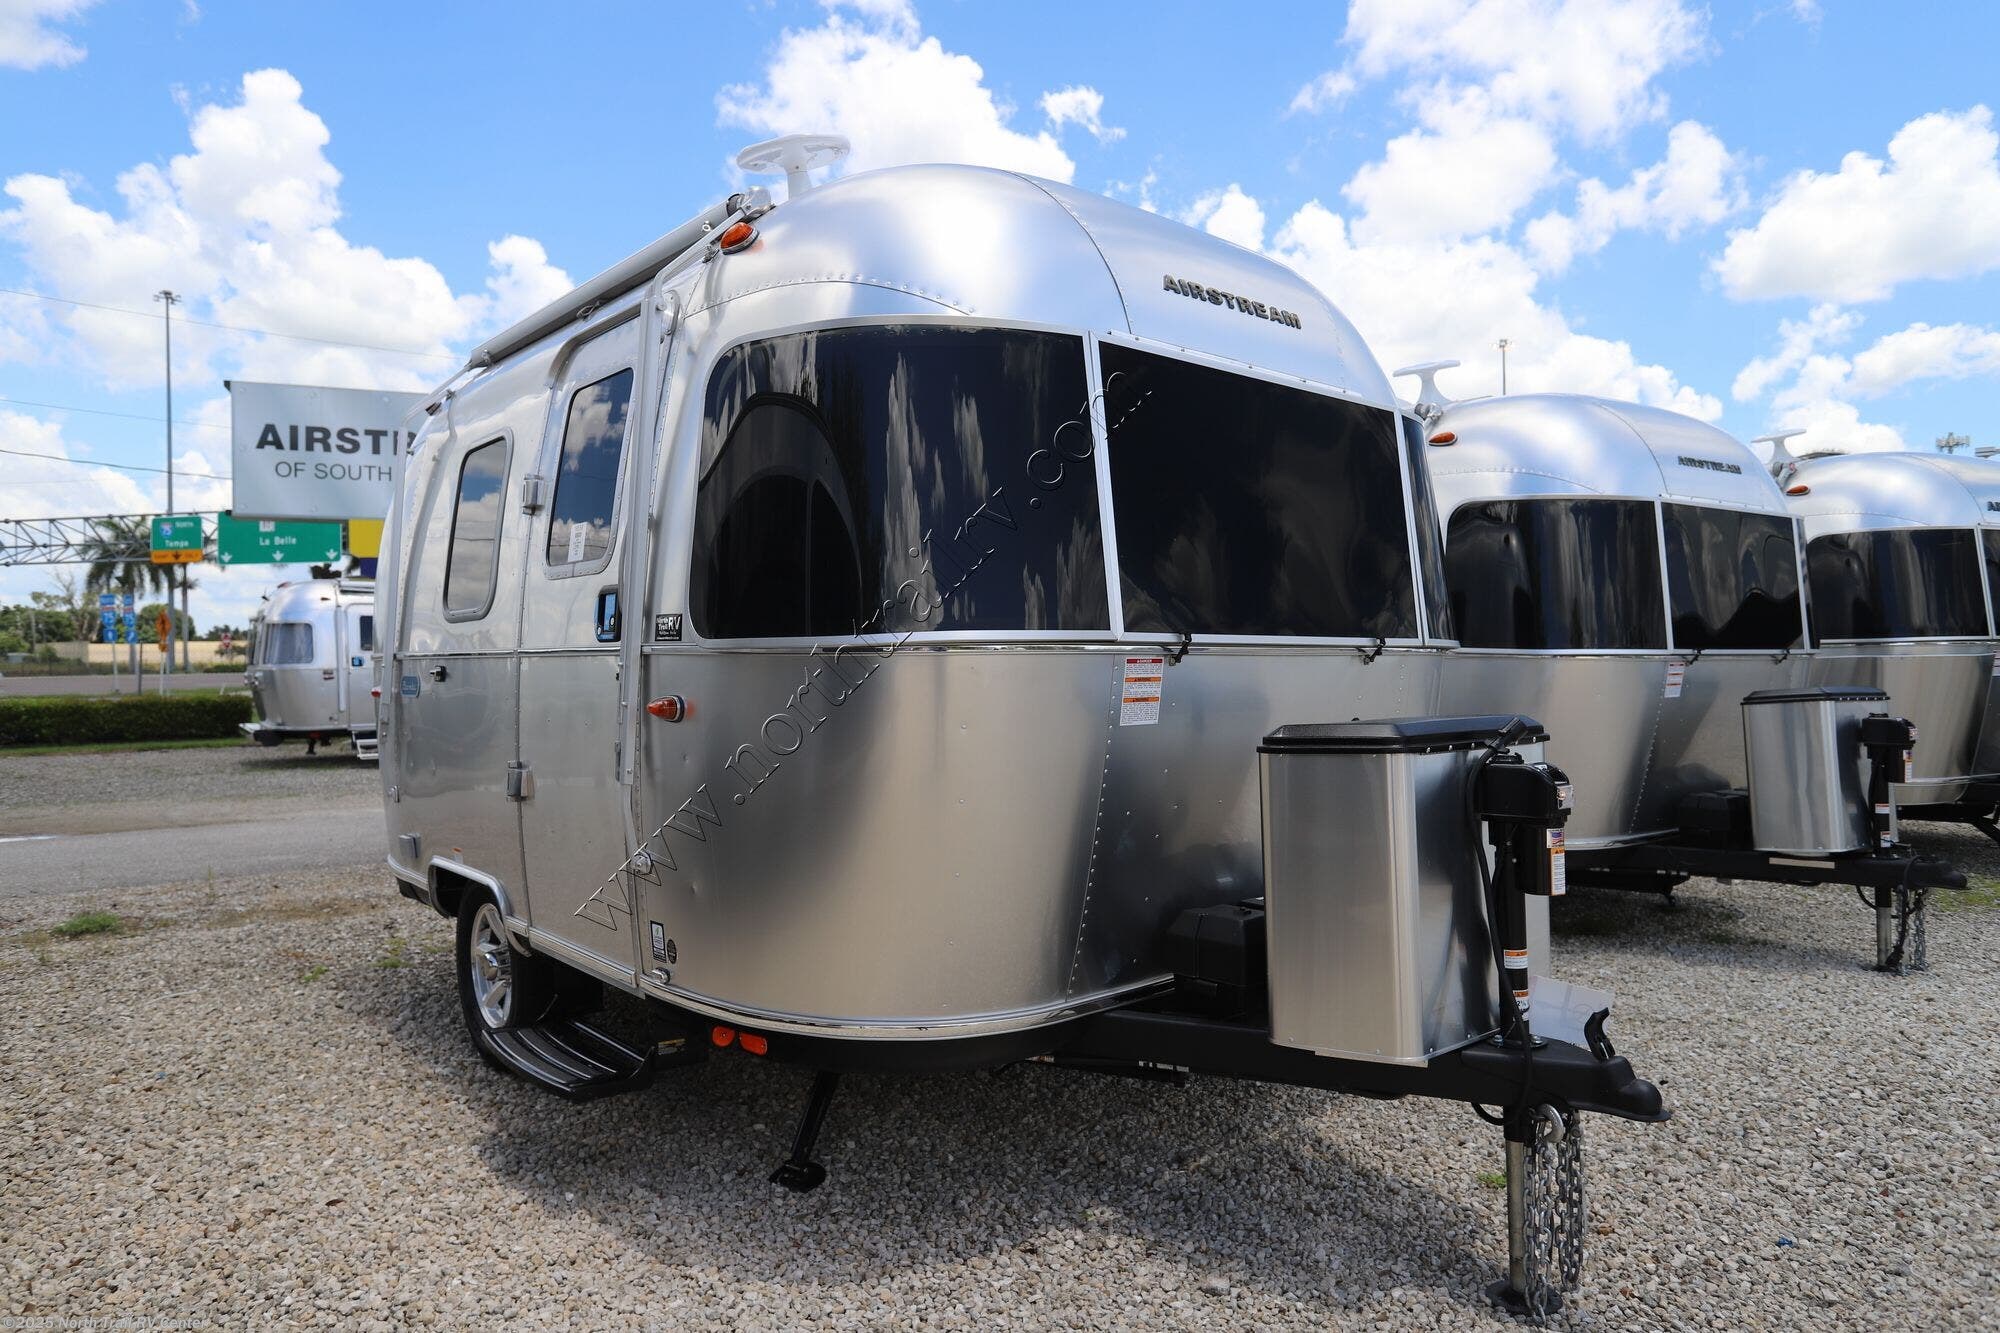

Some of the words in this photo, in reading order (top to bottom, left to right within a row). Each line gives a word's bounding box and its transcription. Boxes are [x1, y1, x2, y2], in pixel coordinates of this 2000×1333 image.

[1163, 274, 1302, 330] AIRSTREAM
[275, 461, 306, 478] OF
[314, 462, 392, 481] SOUTH
[1678, 455, 1742, 475] AIRSTREAM
[259, 536, 271, 546] La
[274, 536, 297, 546] Belle
[668, 616, 681, 630] RV
